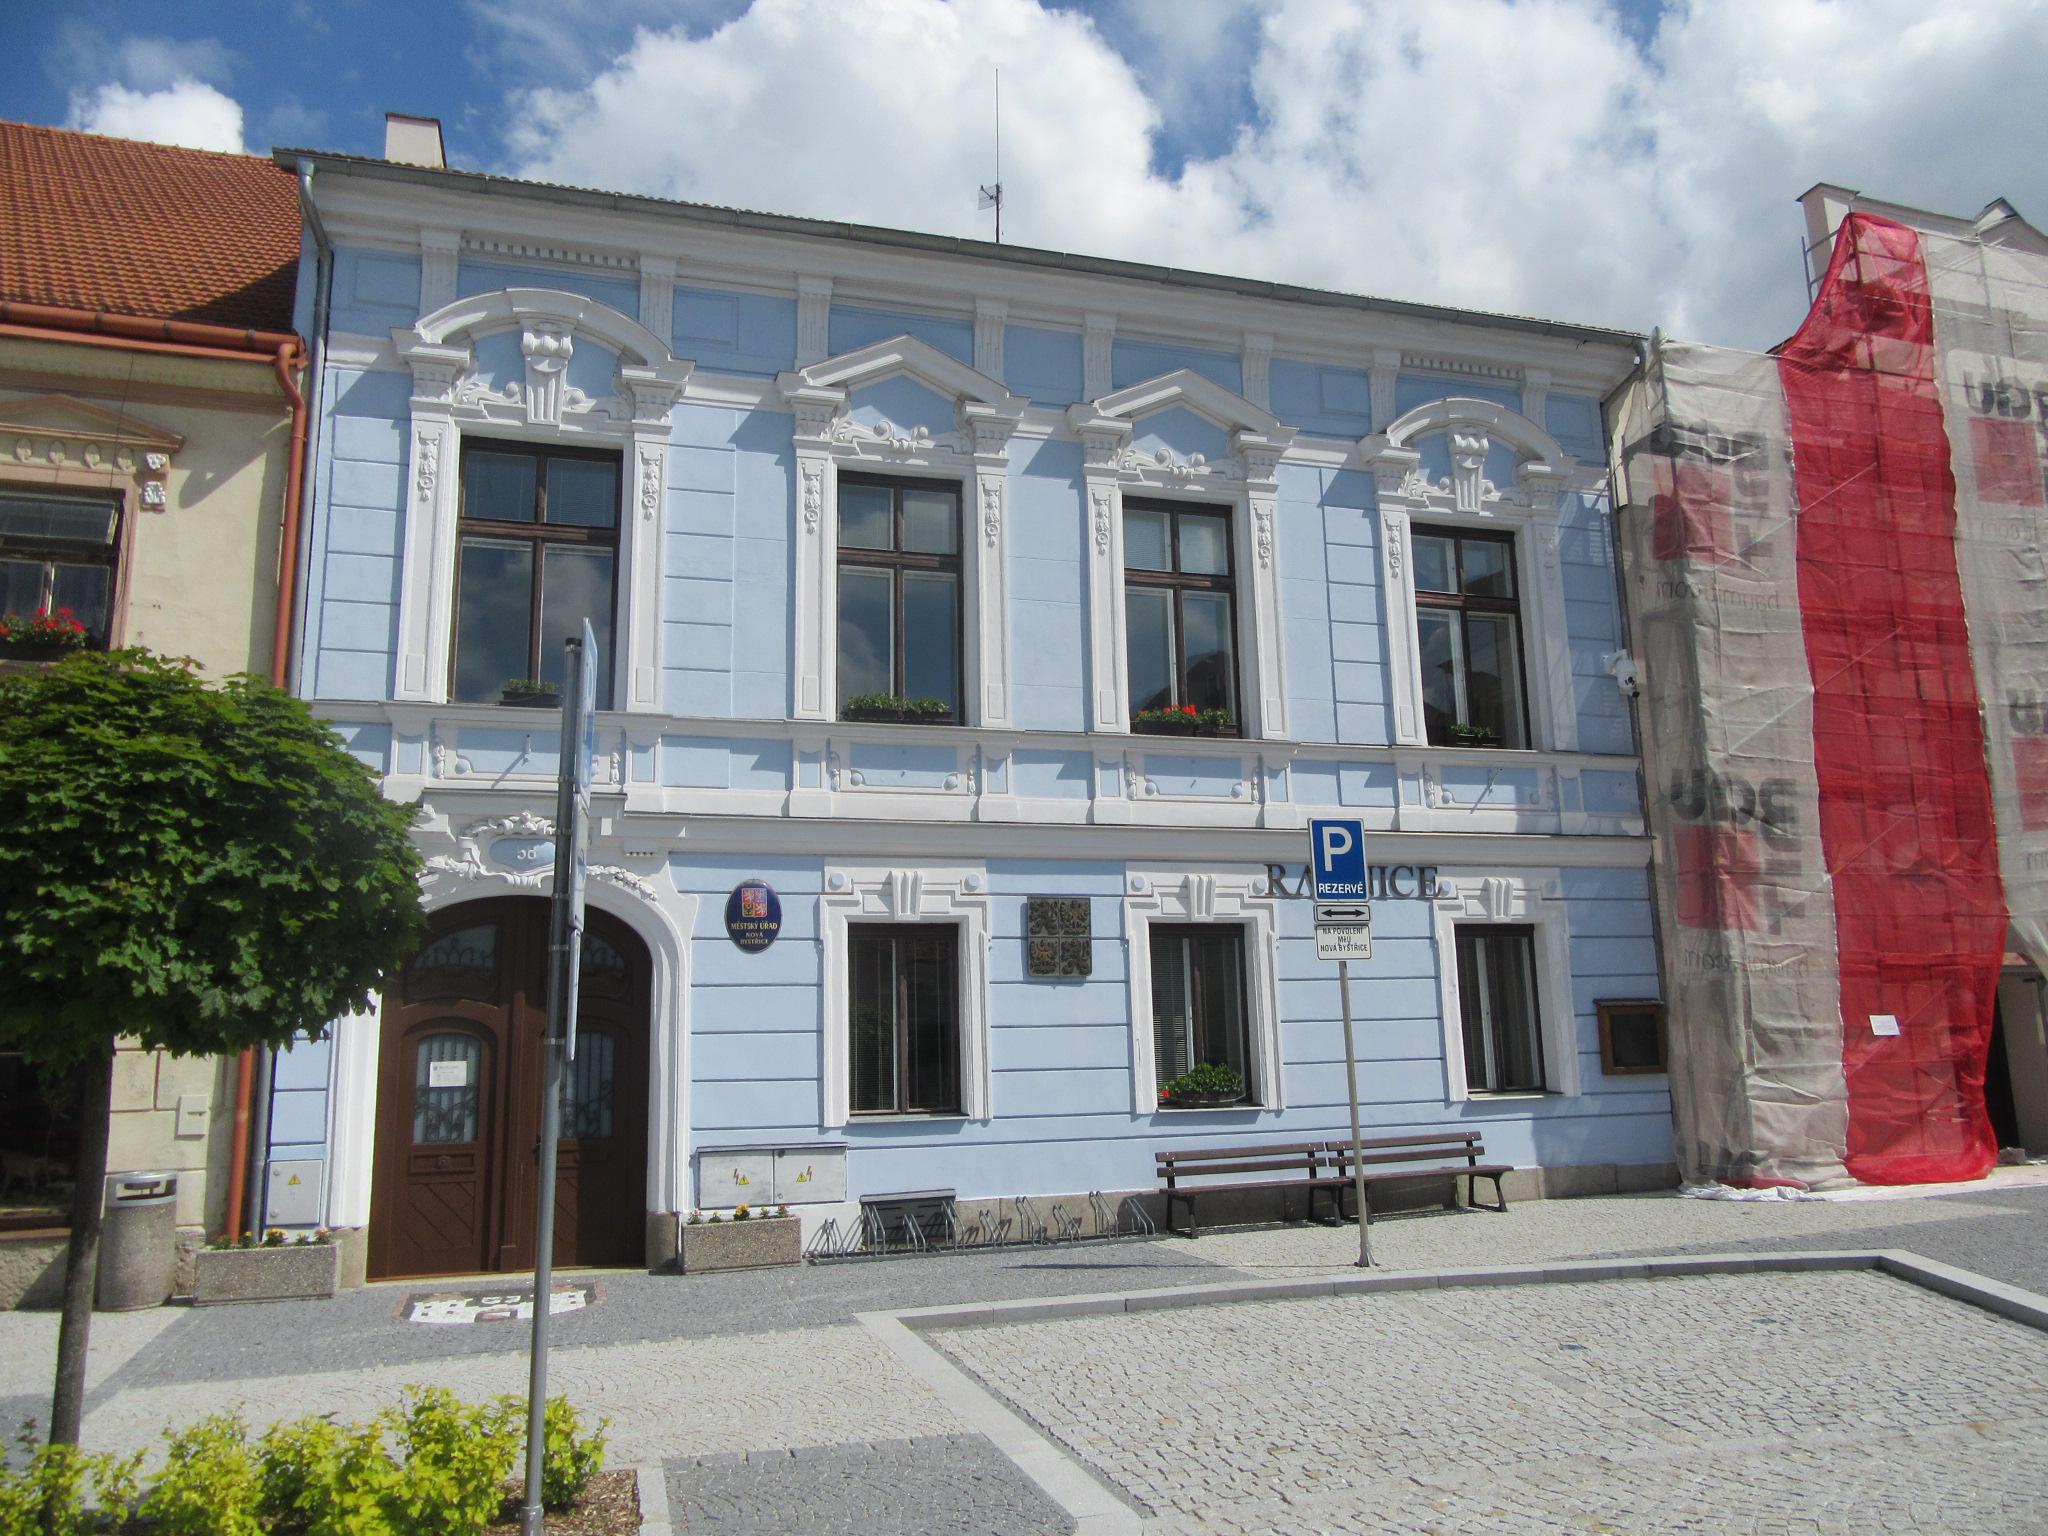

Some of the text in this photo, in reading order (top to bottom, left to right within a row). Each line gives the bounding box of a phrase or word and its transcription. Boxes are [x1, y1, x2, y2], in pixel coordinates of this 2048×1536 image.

[1322, 826, 1353, 872] P
[1264, 863, 1440, 899] RAICE
[1318, 881, 1364, 894] REZERVÉ
[731, 920, 778, 930] MĚSTSKÝ ÚŘAD
[1322, 926, 1363, 935] NA POVOLENÍ
[1320, 943, 1369, 952] NOVÁ BYSTŘICE
